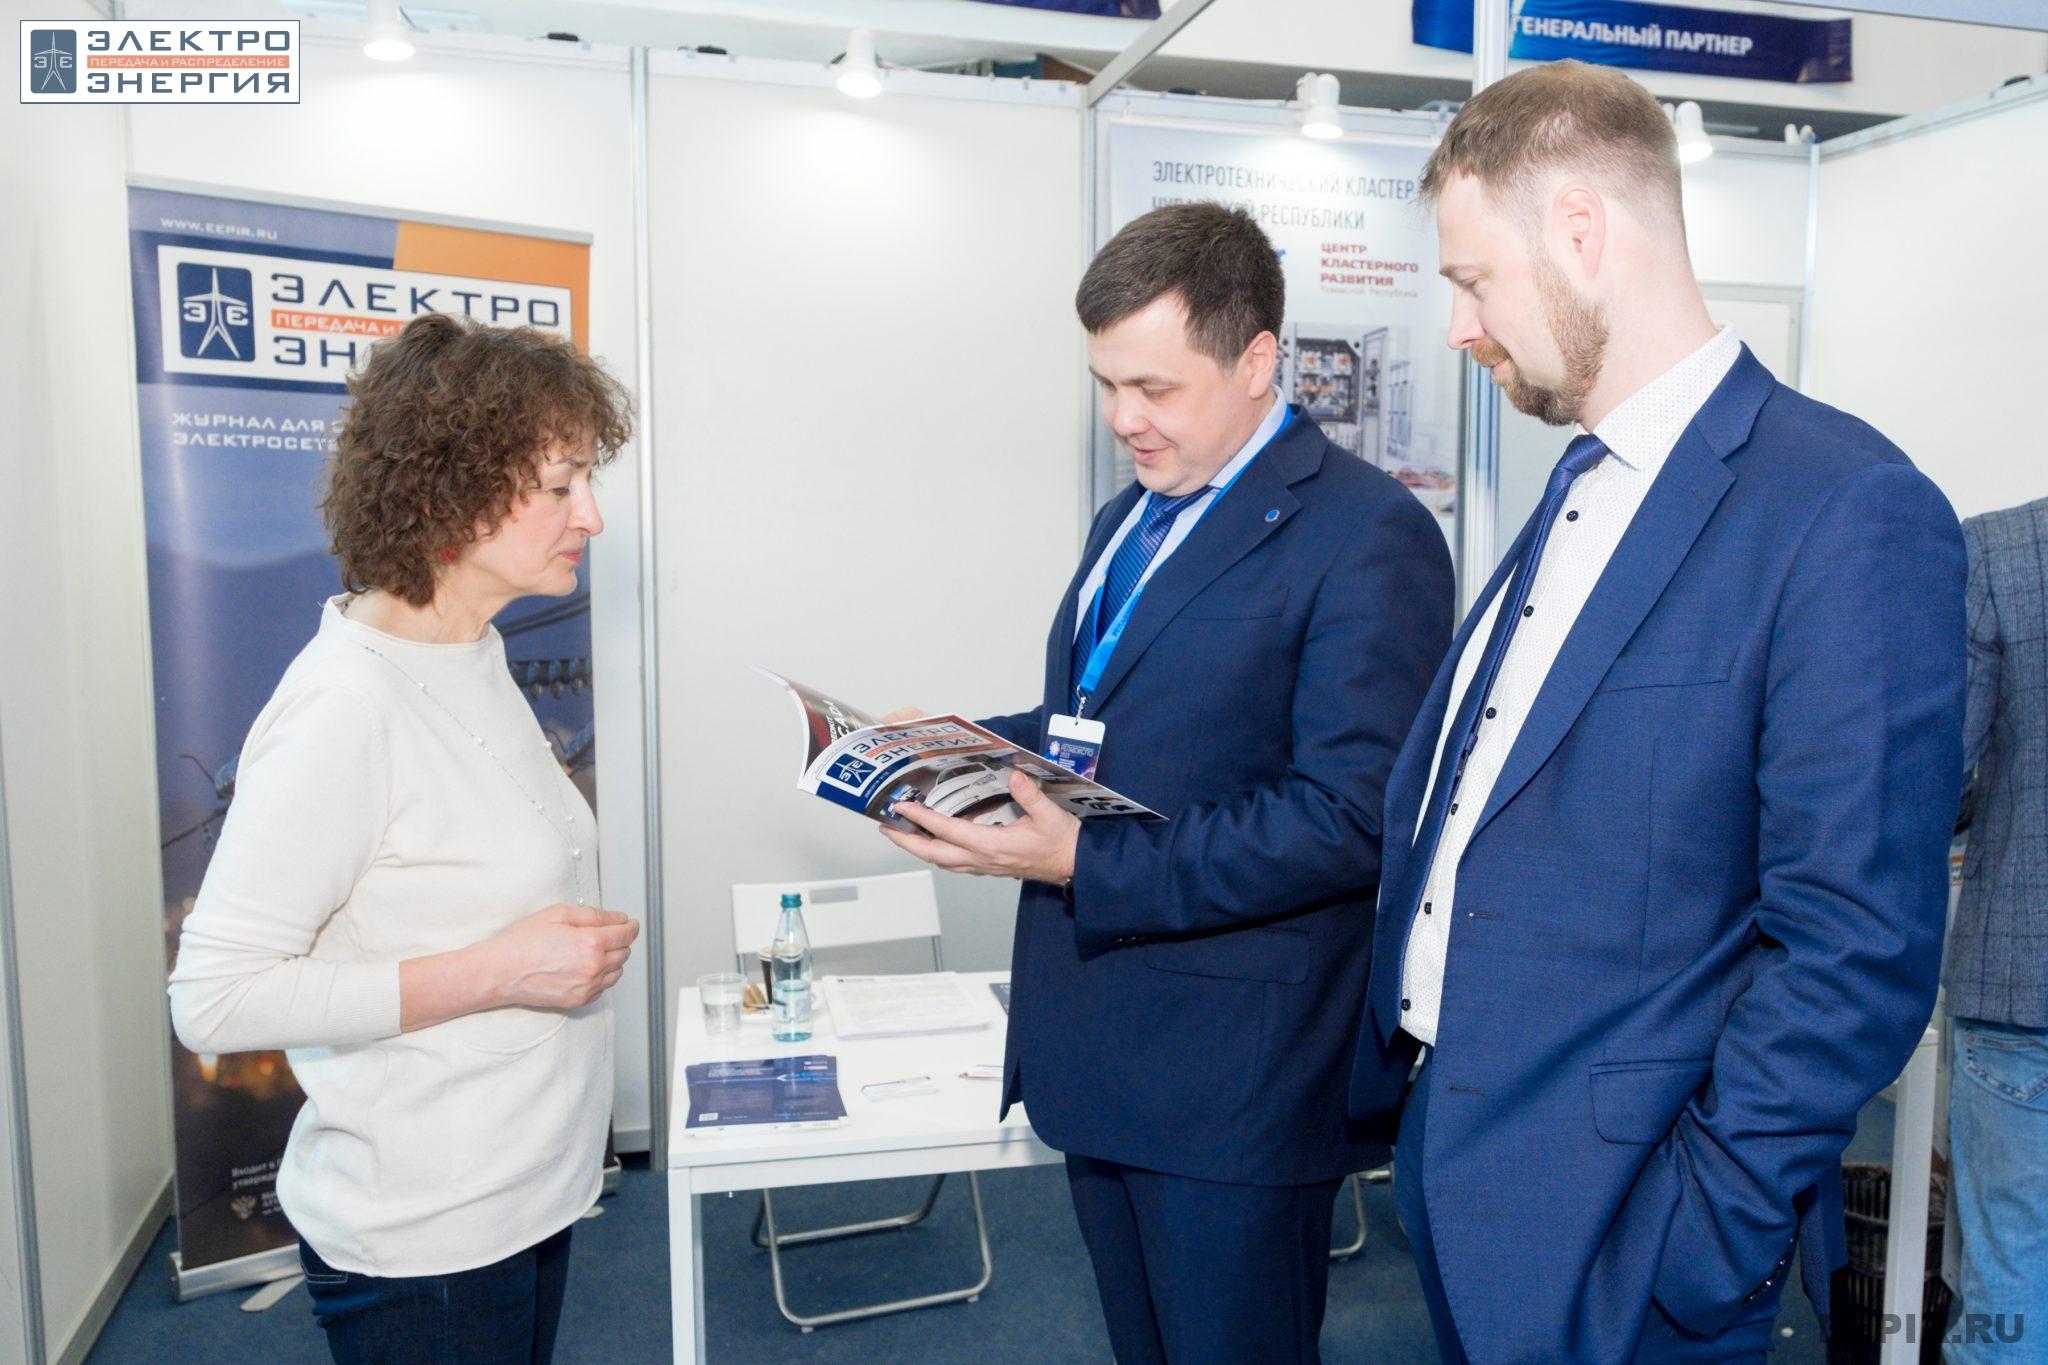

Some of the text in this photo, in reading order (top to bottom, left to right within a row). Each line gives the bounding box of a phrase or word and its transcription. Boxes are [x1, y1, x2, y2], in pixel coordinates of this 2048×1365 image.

[1512, 15, 1754, 57] ГЕНЕРАЛЬНЫЙ ПАРТНЕР
[1345, 176, 1415, 201] КЛАСТЕР
[1260, 206, 1366, 231] РЕСПУБЛИКИ
[1321, 242, 1368, 254] ЦЕНТР
[1320, 257, 1420, 273] КЛАСТЕРНОГО
[1320, 273, 1394, 286] РАЗВИТИЯ
[270, 272, 560, 327] ЭЛЕКТРО
[274, 312, 379, 335] ПЕРЕДАЧА
[172, 411, 277, 430] ЖУРНАЛ
[279, 418, 325, 433] ДЛЯ
[852, 724, 960, 754] ЭЛЕКТРО
[874, 736, 983, 764] ЭНЕРГИЯ
